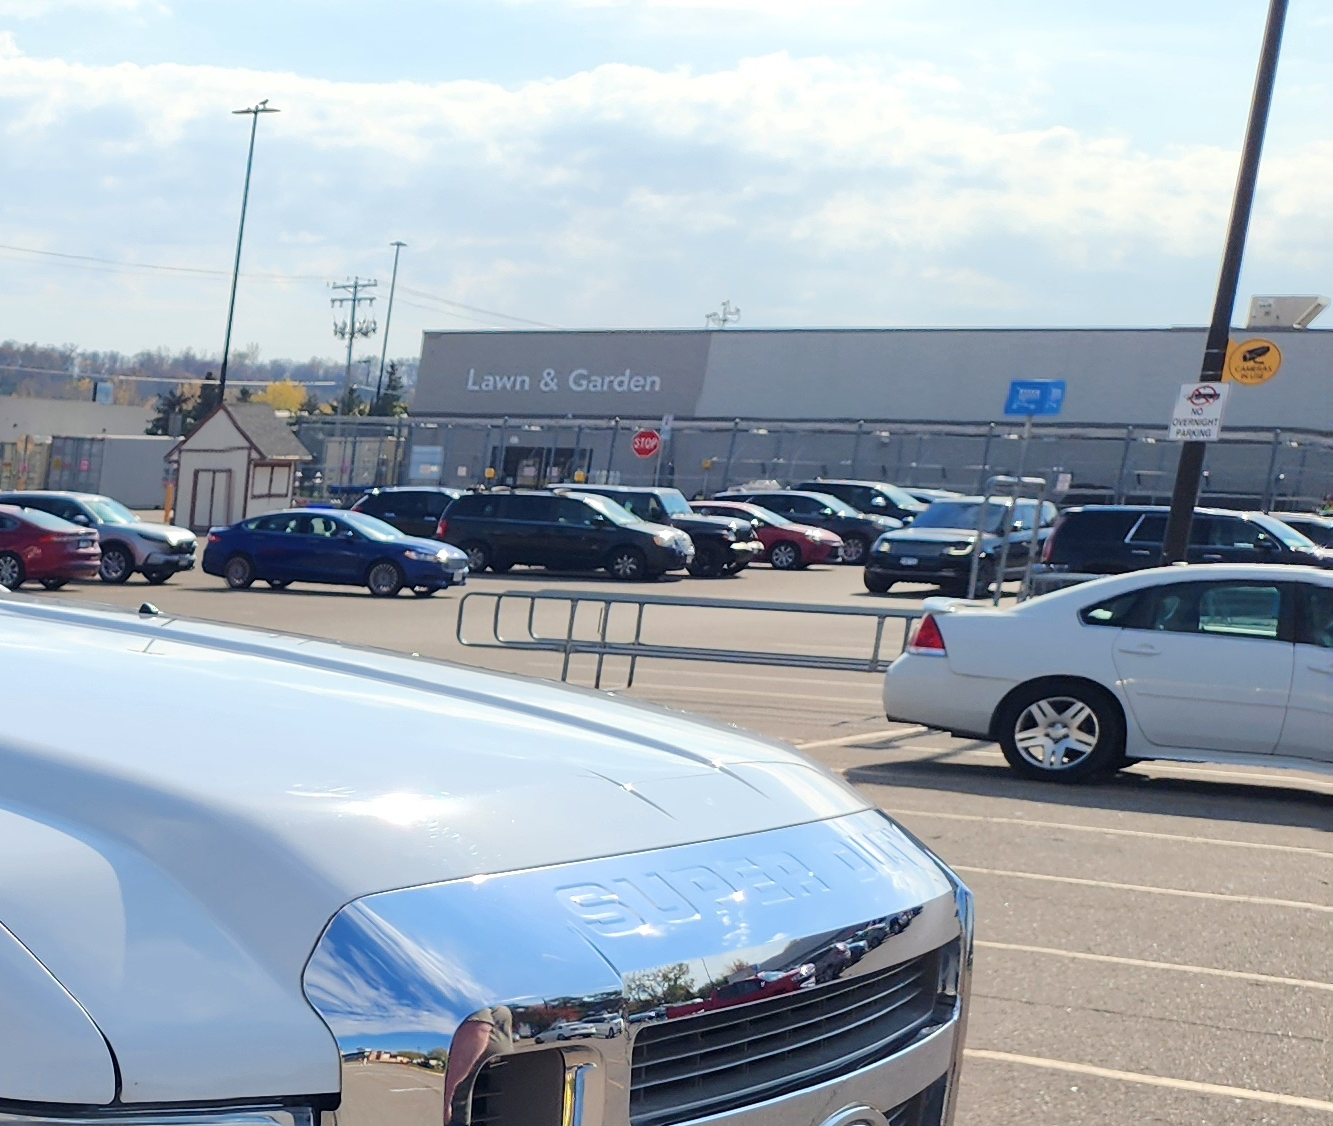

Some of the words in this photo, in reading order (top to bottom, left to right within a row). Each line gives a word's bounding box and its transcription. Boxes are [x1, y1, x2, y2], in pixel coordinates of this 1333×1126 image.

[467, 368, 530, 391] Lawn
[540, 368, 558, 391] &
[568, 368, 661, 392] Garden
[1176, 429, 1211, 437] PARKING
[634, 437, 658, 450] STOP
[553, 850, 831, 938] SUPER
